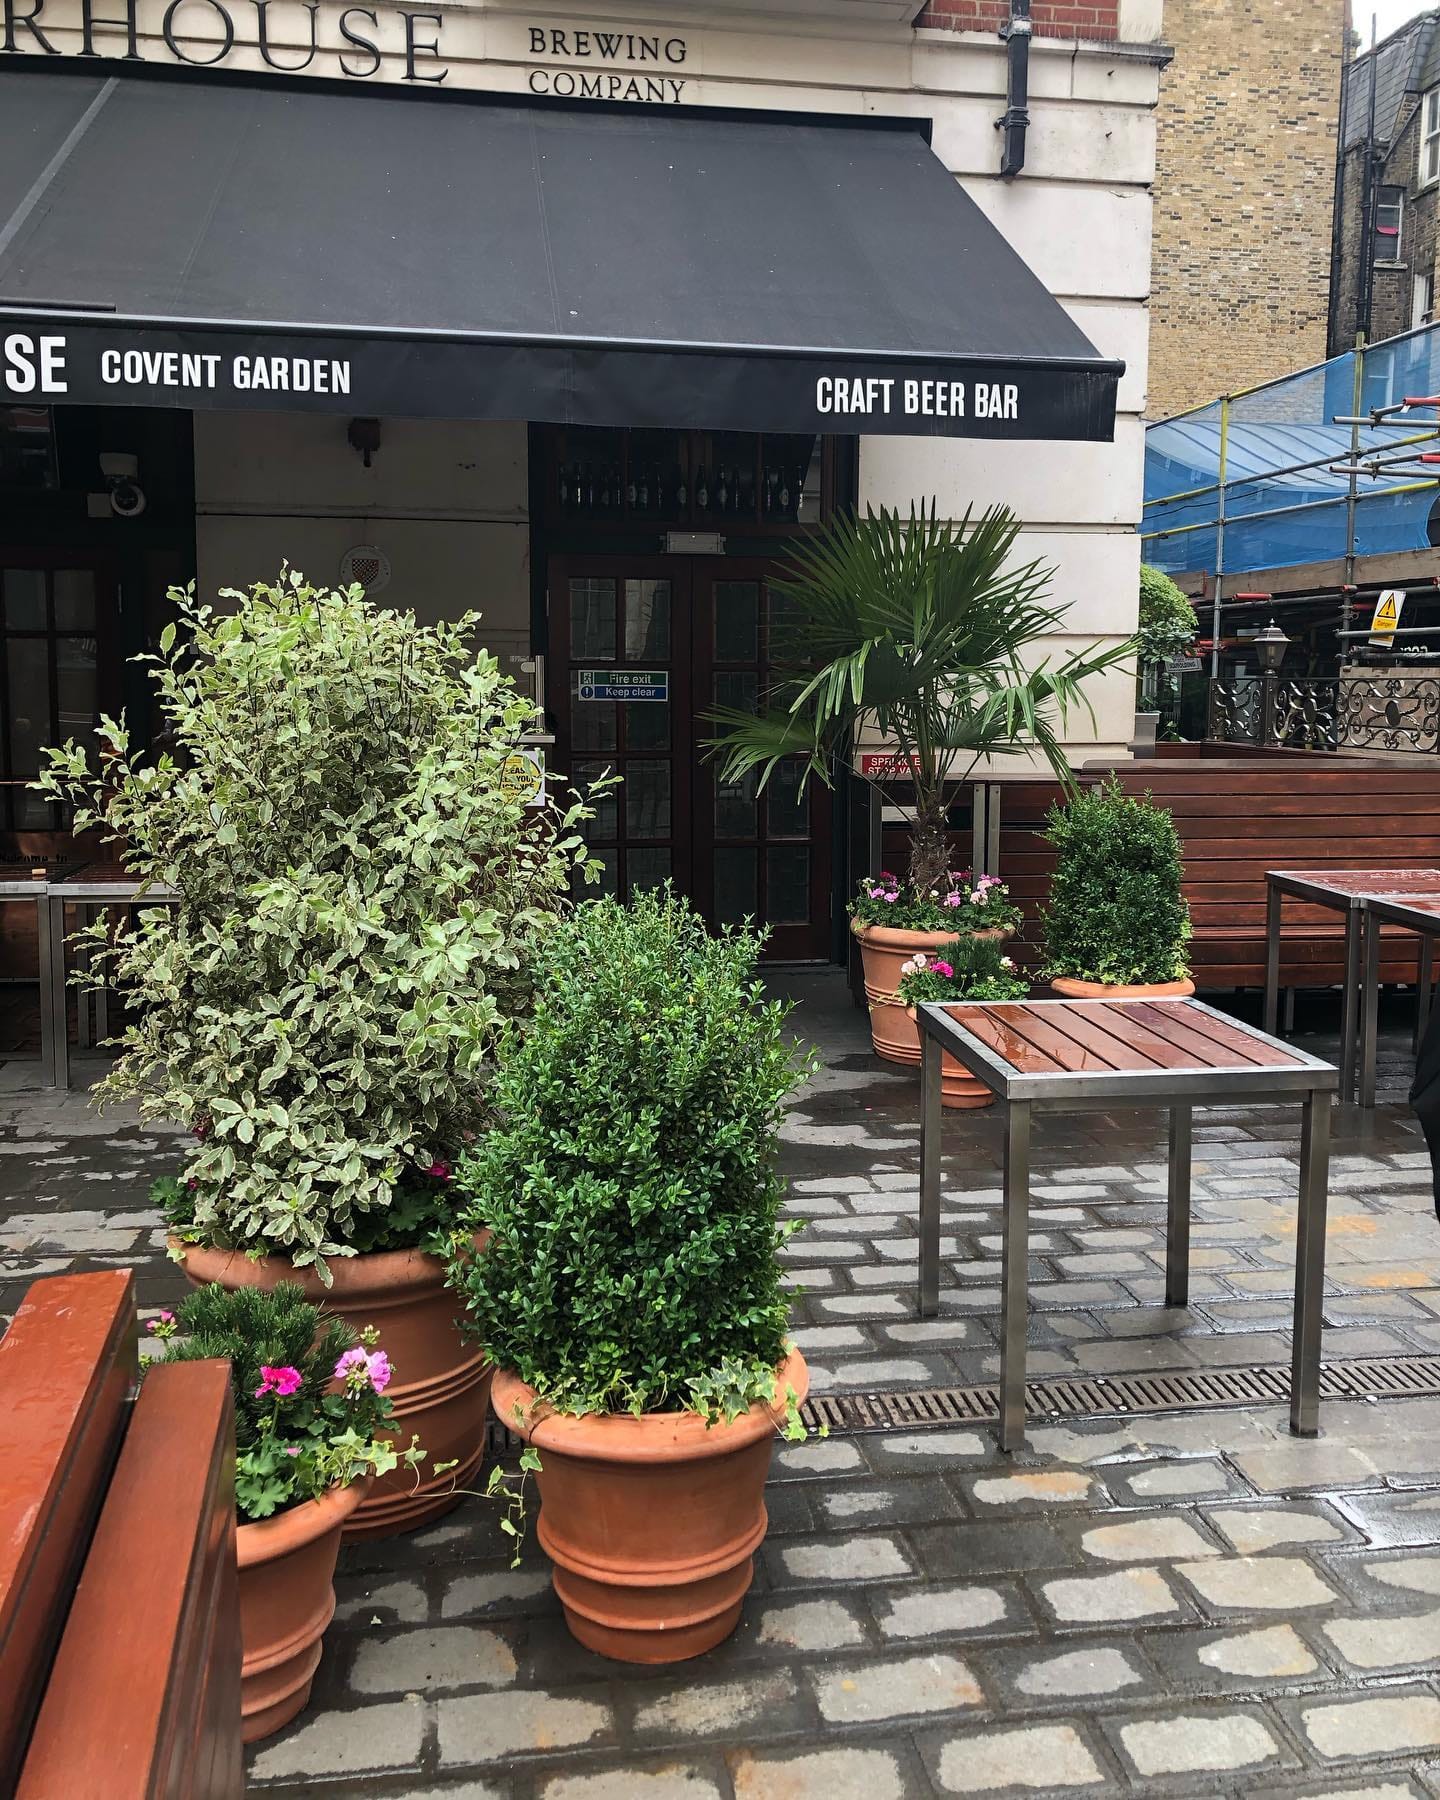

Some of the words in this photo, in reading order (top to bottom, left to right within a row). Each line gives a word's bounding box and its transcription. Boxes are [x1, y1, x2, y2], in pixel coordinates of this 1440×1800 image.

[528, 27, 687, 63] BREWING
[529, 70, 686, 103] COMPANY
[4, 334, 68, 393] SE
[101, 350, 221, 388] COVENT
[233, 356, 350, 394] GARDEN
[816, 377, 895, 414] CRAFT
[904, 380, 965, 417] BEER
[974, 383, 1018, 419] BAR
[605, 687, 630, 698] Keep
[632, 687, 656, 697] clear
[609, 674, 630, 684] Fire
[632, 674, 652, 684] exit
